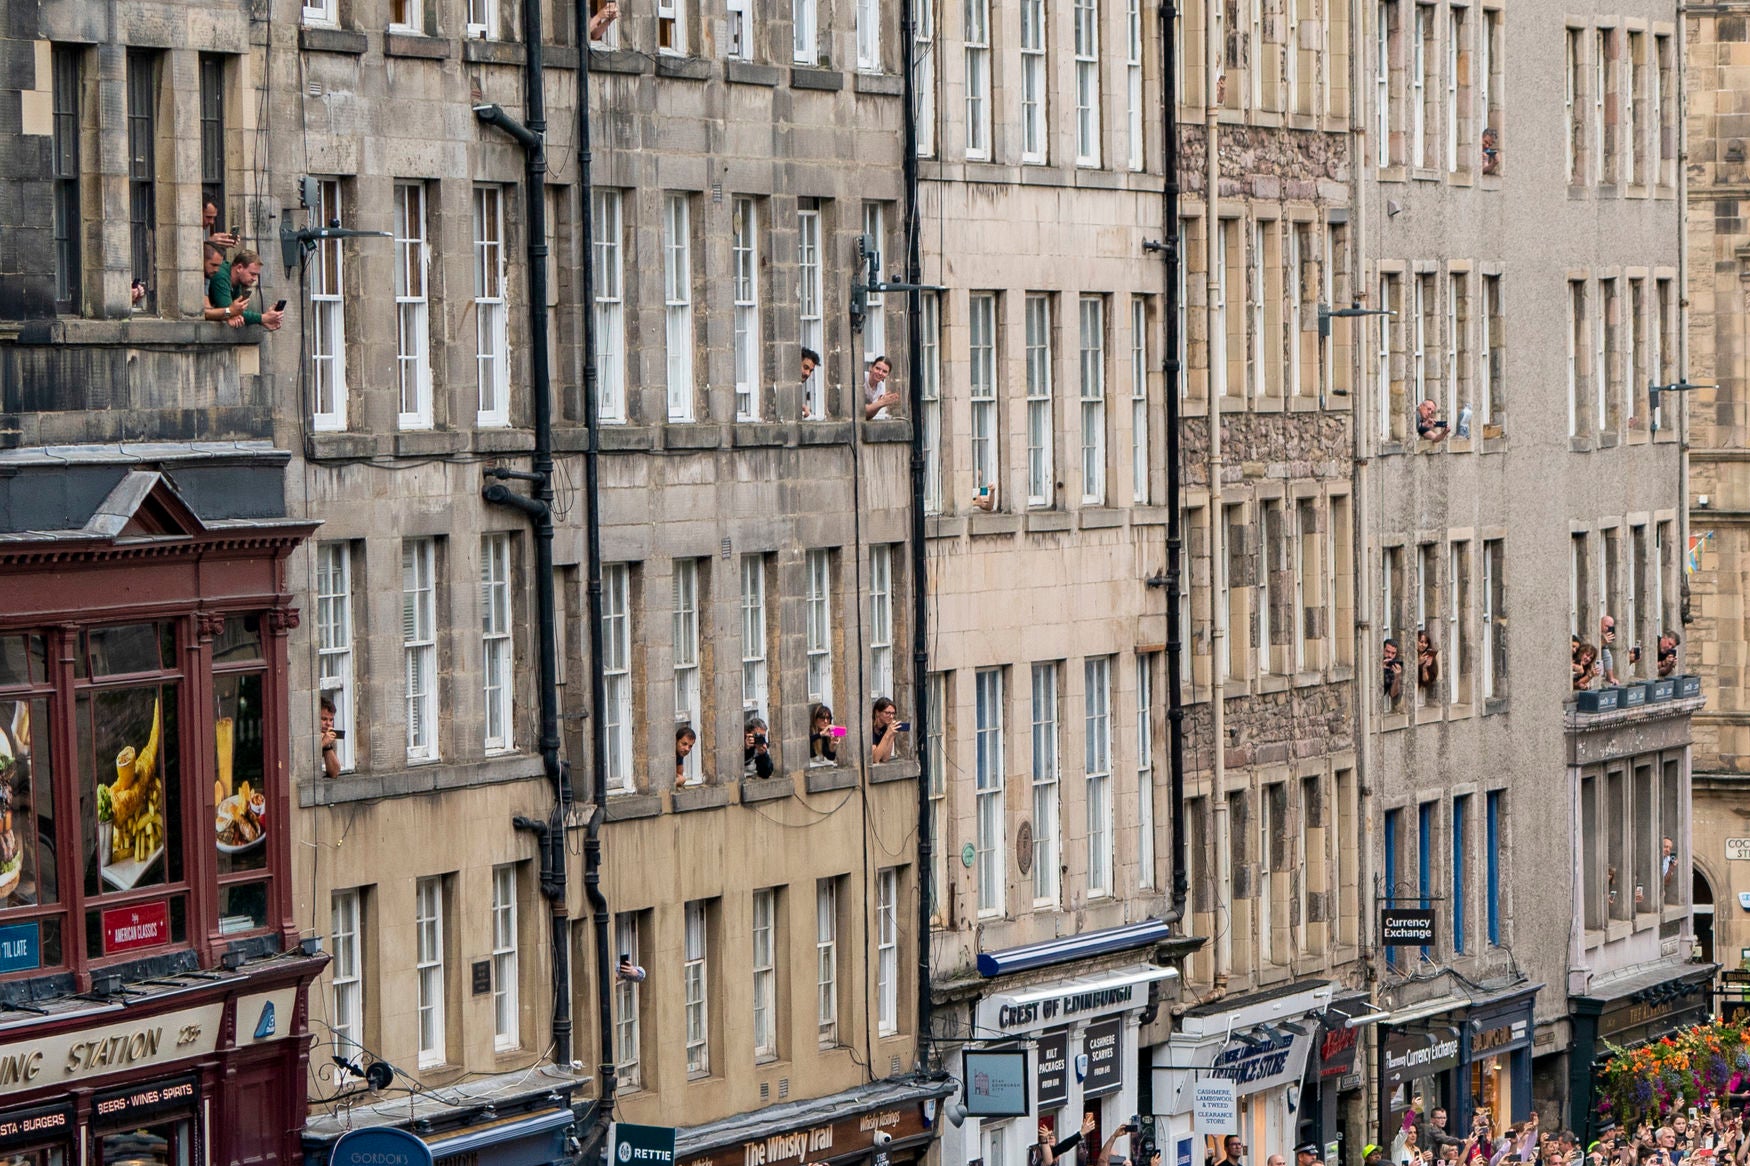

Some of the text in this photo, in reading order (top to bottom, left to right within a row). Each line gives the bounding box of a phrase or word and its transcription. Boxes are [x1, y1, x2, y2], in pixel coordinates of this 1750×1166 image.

[1385, 917, 1431, 929] Currency
[115, 922, 158, 944] AMERICAN CLASSICS
[1384, 928, 1432, 940] Exchange
[13, 939, 28, 957] LATE
[999, 985, 1133, 1029] CREST OF EDINBURGH
[66, 1027, 164, 1073] STATION
[1089, 1034, 1116, 1049] CASHMERE
[1045, 1047, 1058, 1059] KILT
[1091, 1046, 1114, 1062] SCARVES
[1406, 1047, 1432, 1067] Currency
[1432, 1038, 1458, 1060] Exchange
[1038, 1058, 1065, 1075] PACKAGES
[1257, 1050, 1290, 1080] STORE
[98, 1083, 193, 1115] BEERS WINES SPIRITS
[1195, 1095, 1233, 1103] LAMBSWOOL
[1197, 1088, 1232, 1098] CASHMERE,
[23, 1113, 66, 1133] BURGERS
[859, 1110, 900, 1132] Whisky Tastings
[766, 1130, 808, 1164] Whisky
[809, 1124, 834, 1151] Trail
[350, 1152, 409, 1165] GORDON'S
[634, 1148, 672, 1161] RETTIE
[876, 1152, 887, 1161] THE
